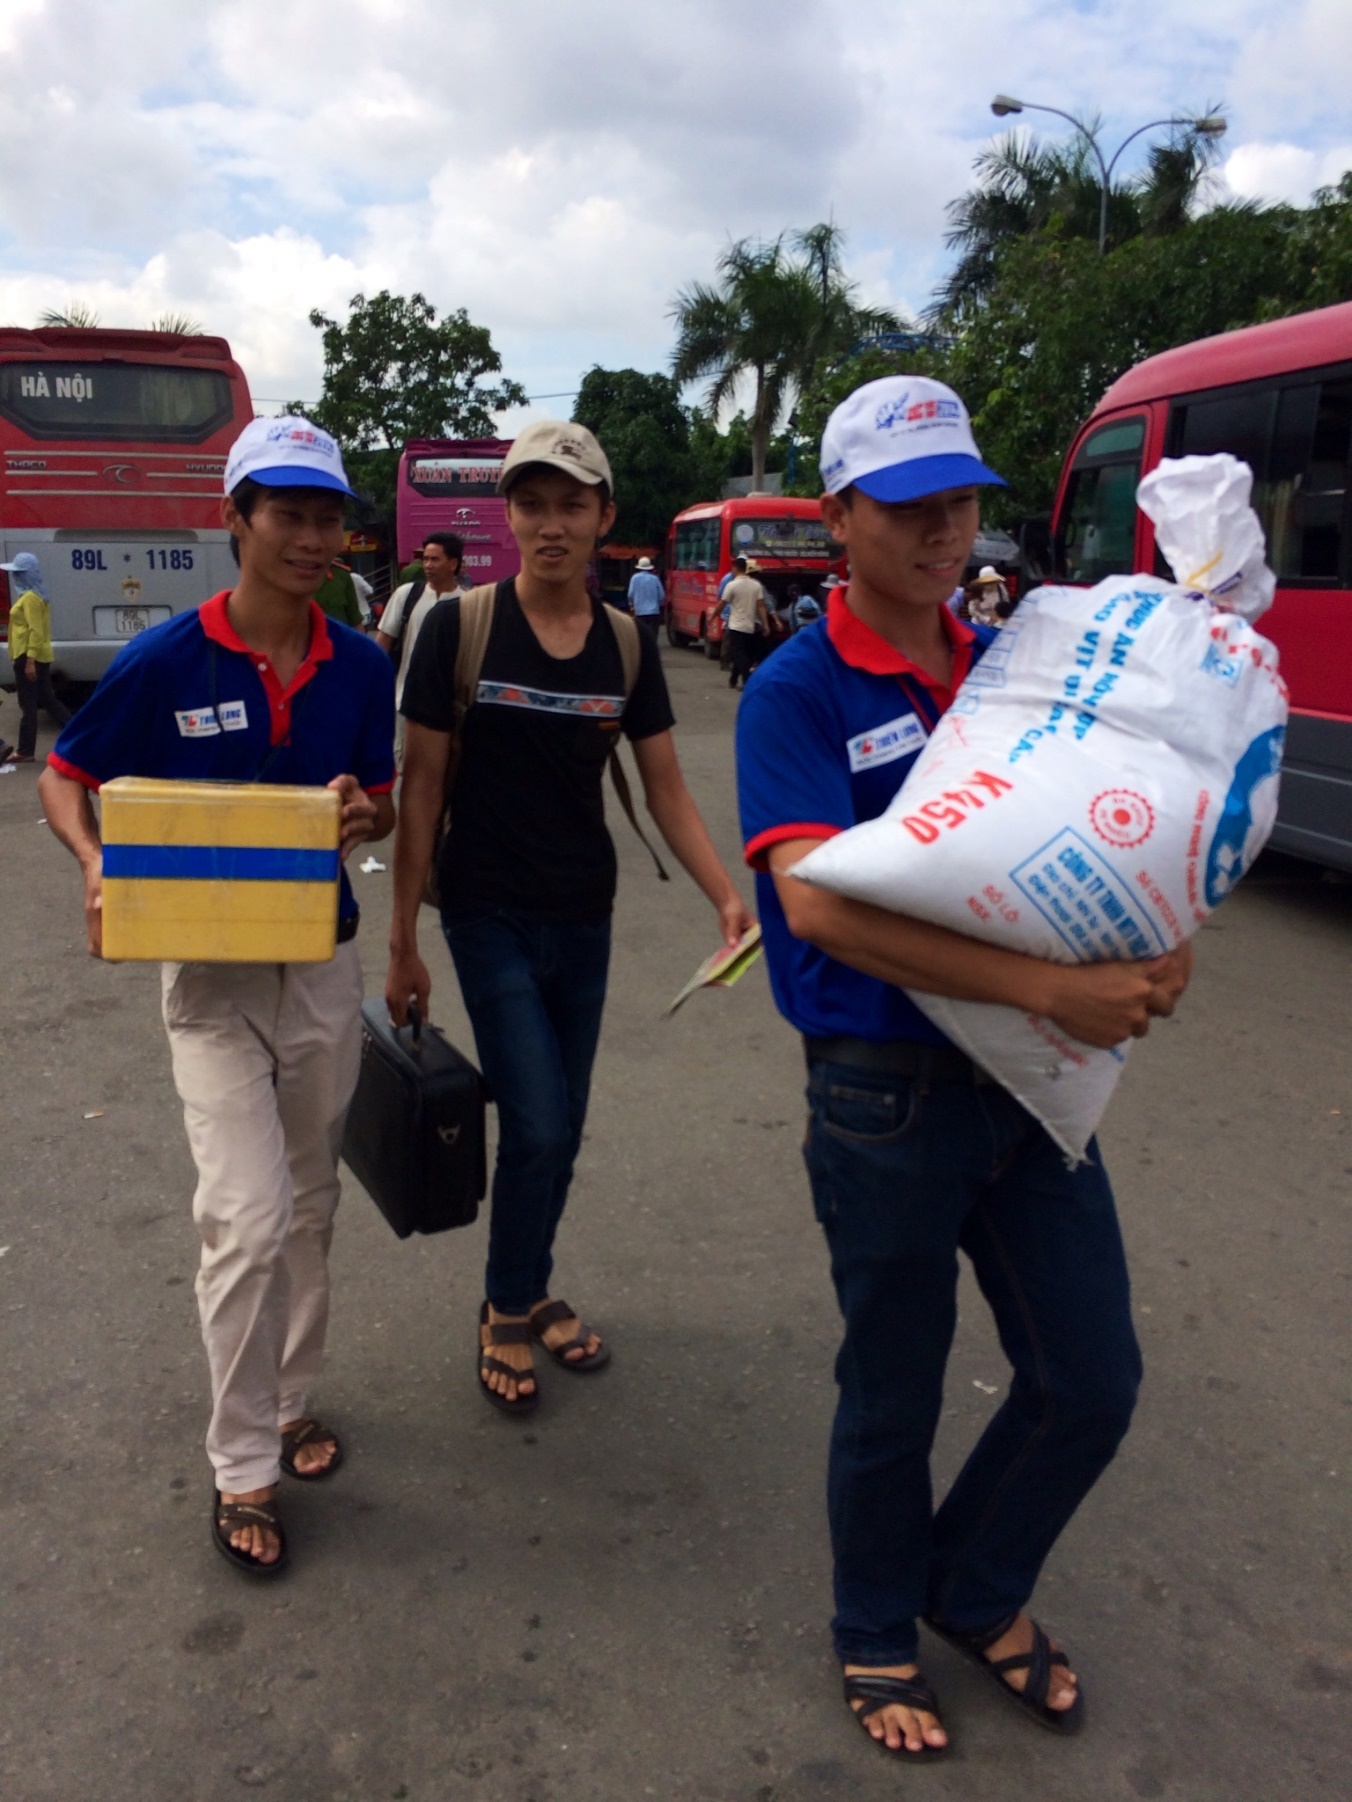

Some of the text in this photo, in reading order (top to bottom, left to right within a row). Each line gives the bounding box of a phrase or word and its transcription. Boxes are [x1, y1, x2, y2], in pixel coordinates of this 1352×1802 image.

[21, 371, 93, 402] HÀ NỘI
[71, 549, 194, 571] 89L 1185
[903, 771, 1012, 846] K450
